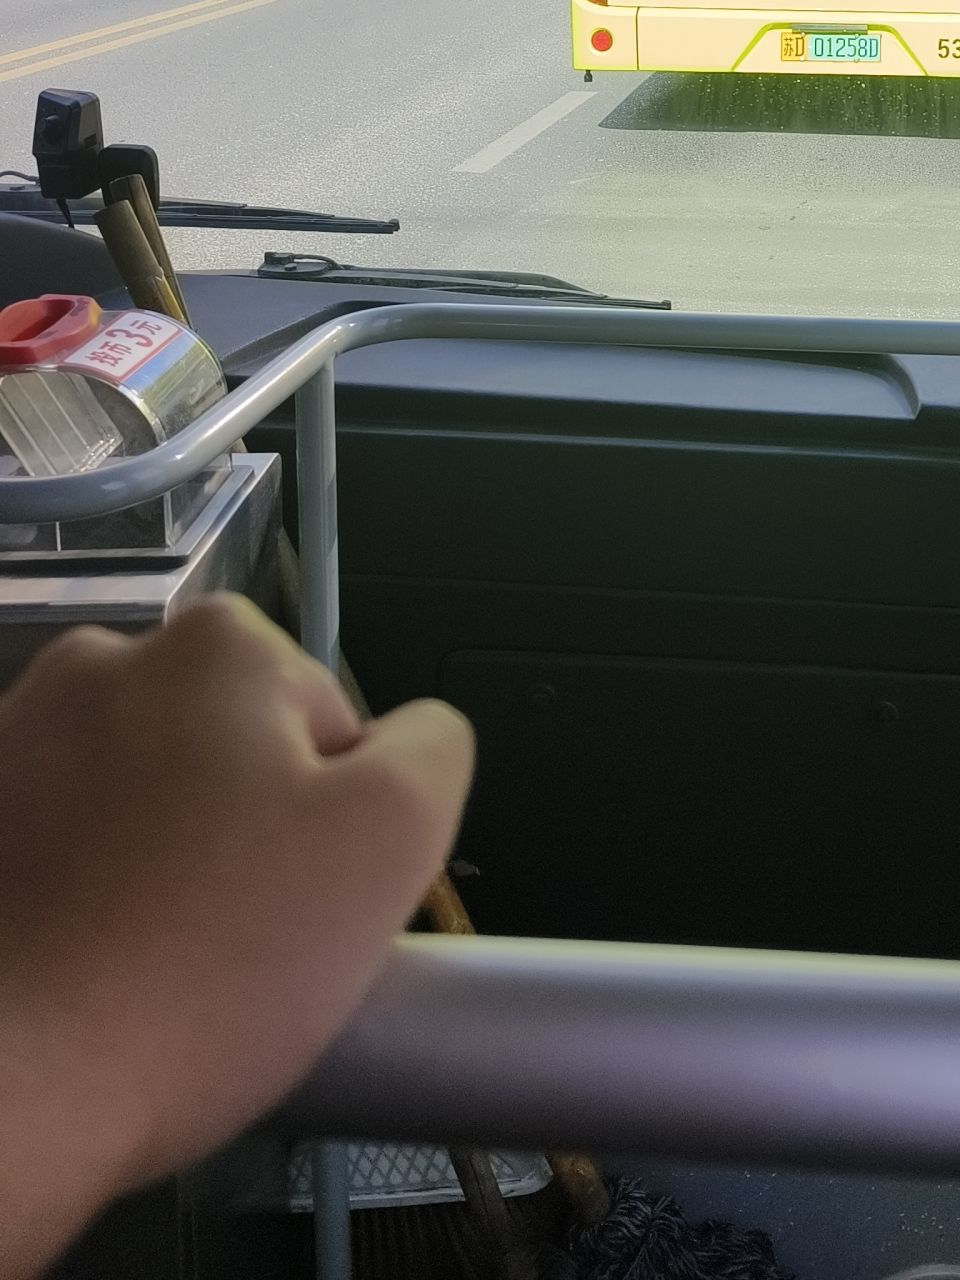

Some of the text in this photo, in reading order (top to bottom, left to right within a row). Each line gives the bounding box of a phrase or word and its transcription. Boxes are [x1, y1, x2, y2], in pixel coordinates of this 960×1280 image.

[814, 37, 879, 58] 01258D
[84, 320, 163, 368] 投币3元
